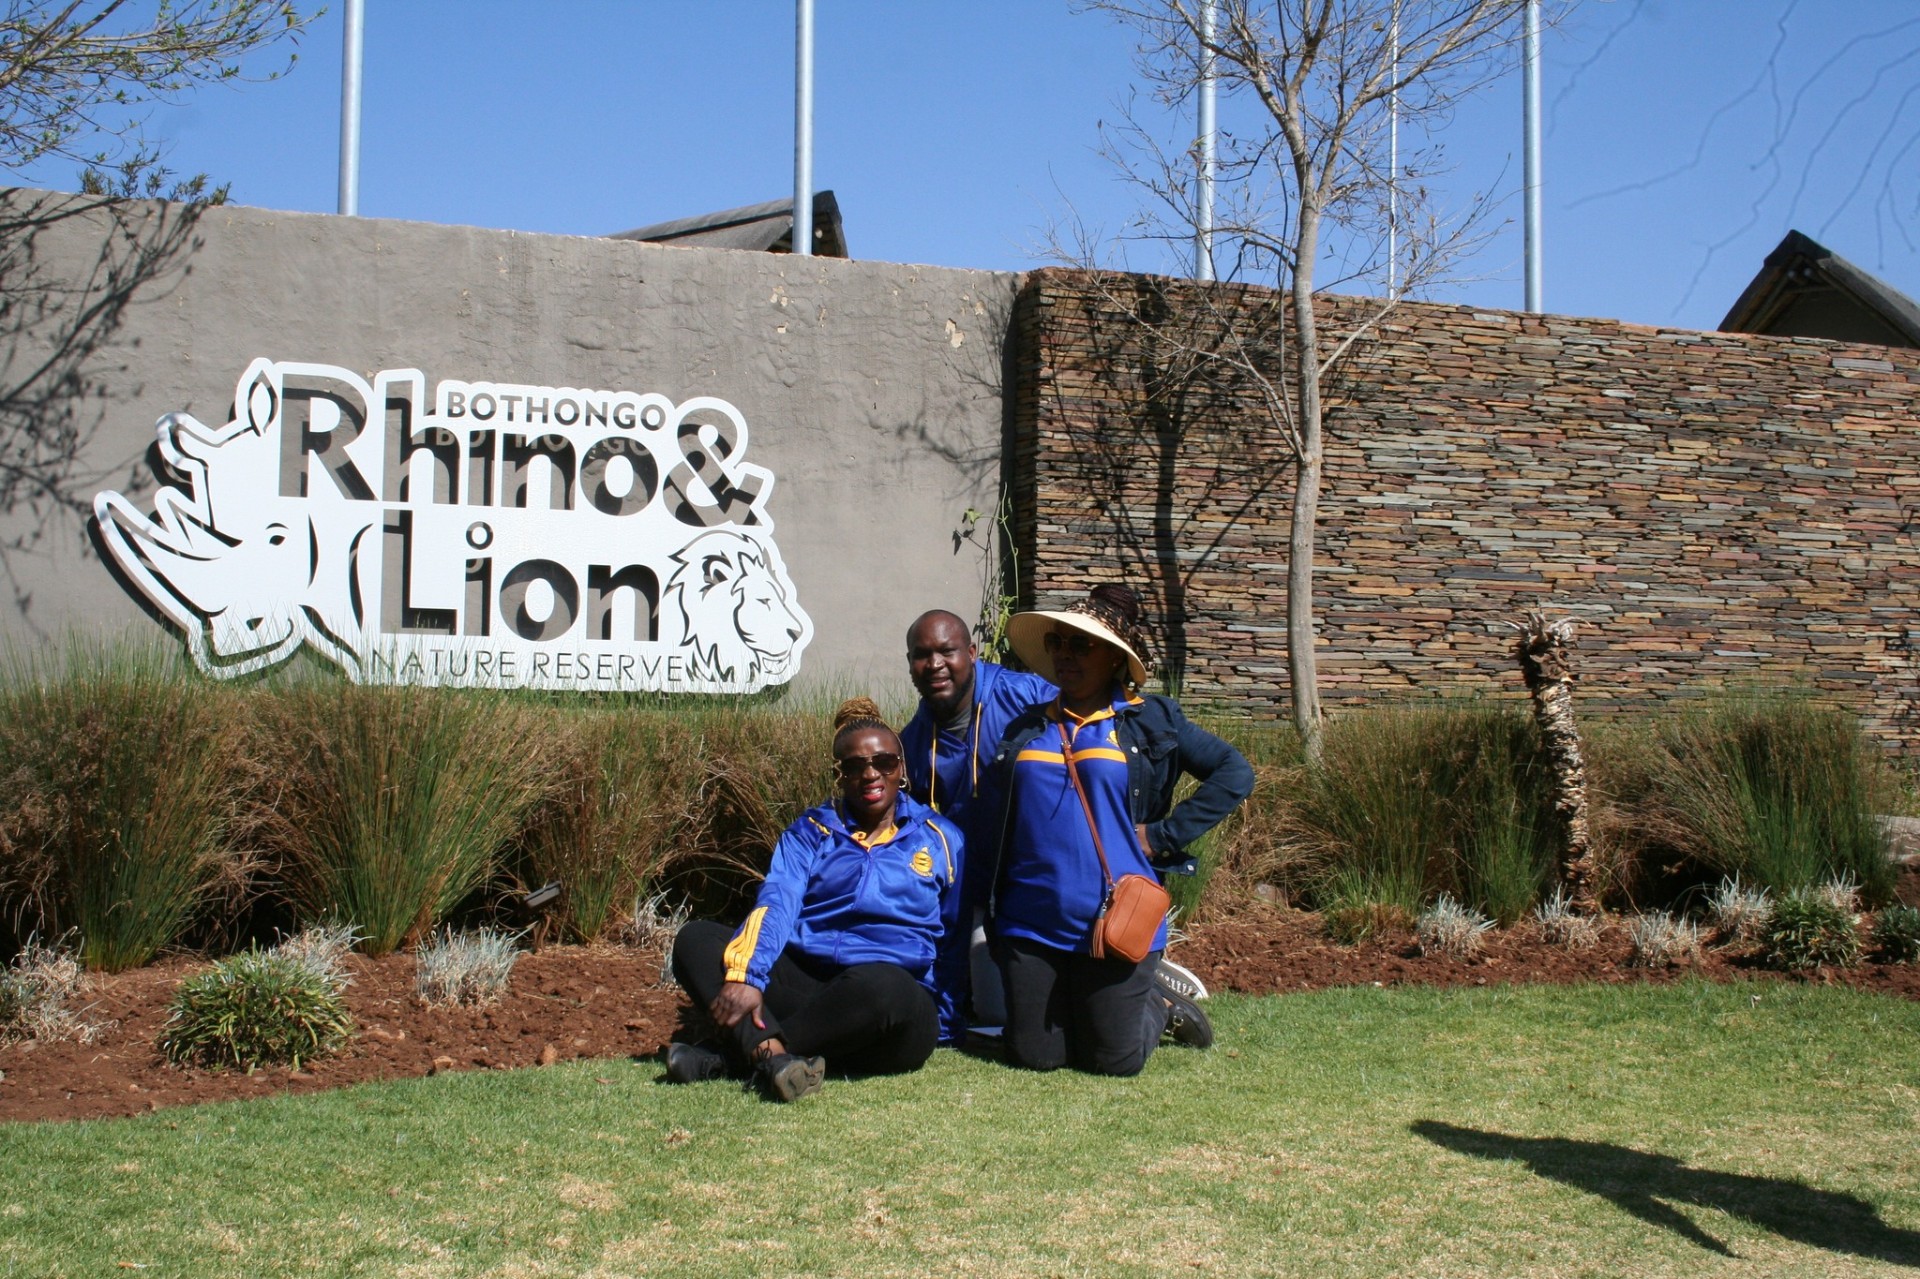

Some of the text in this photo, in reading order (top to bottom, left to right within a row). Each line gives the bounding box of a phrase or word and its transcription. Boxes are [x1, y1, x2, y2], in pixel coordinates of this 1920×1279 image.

[278, 373, 765, 527] Rhino &
[447, 391, 666, 431] BOTHONGO
[381, 509, 660, 642] Lion
[371, 649, 683, 682] NATURE RESERVE
